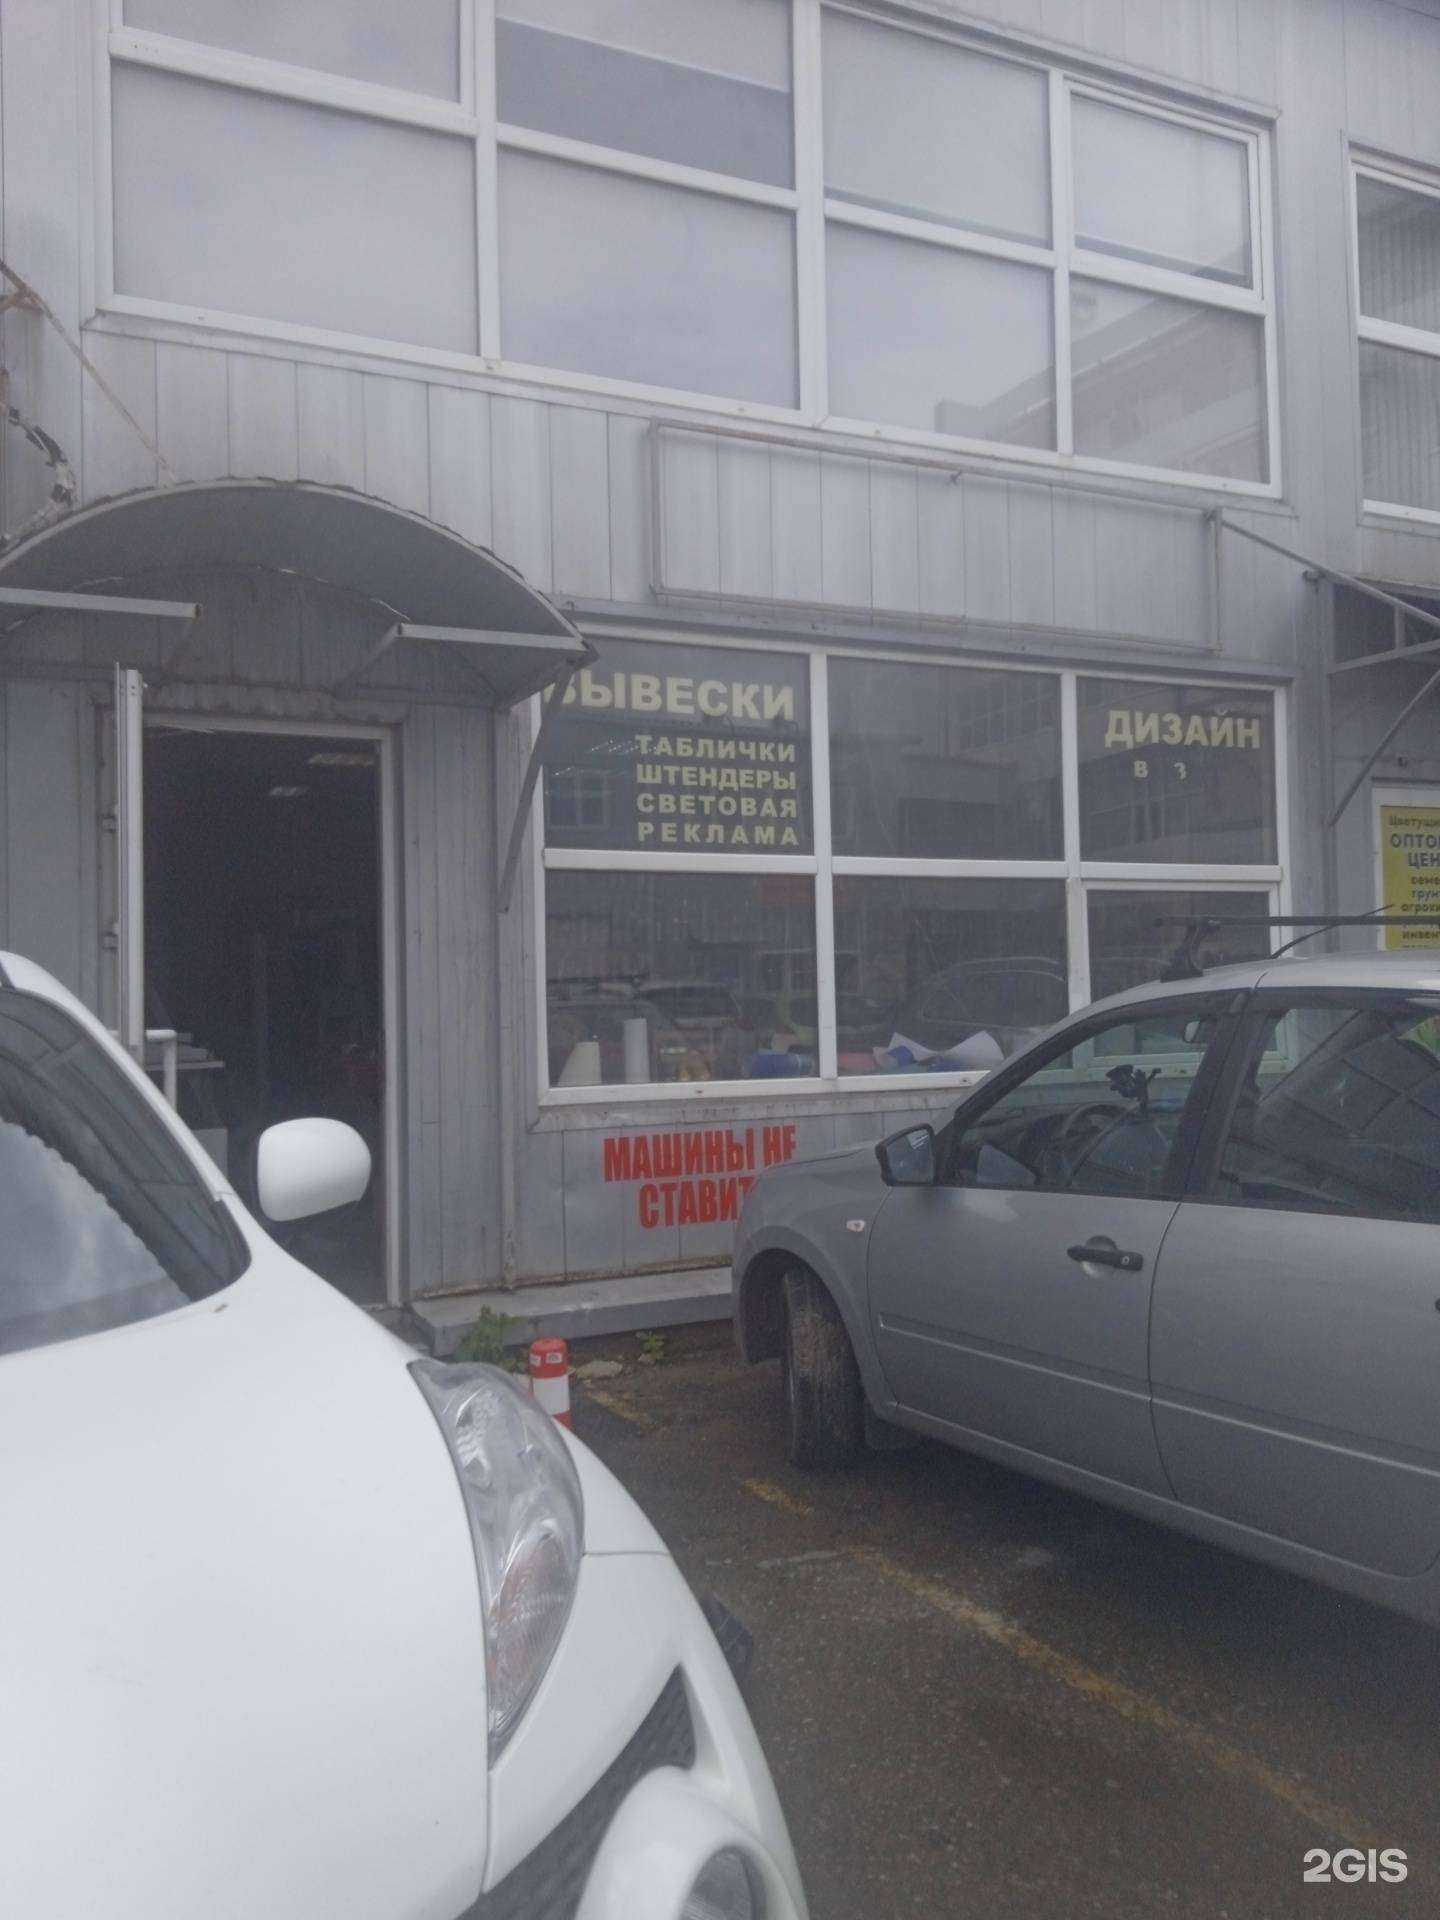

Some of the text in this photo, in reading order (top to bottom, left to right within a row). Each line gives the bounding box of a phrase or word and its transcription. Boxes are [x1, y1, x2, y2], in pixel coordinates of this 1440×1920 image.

[1104, 706, 1261, 750] ДИЗАЙН
[635, 734, 796, 763] ТАБЛИЧКИ
[636, 764, 796, 790] ШТЕНДЕРЫ
[636, 793, 798, 818] СВЕТОВАЯ
[638, 822, 799, 846] РЕКЛАМА
[1390, 833, 1440, 849] ОПТО
[604, 1125, 796, 1183] МАШИНЫ НЕ
